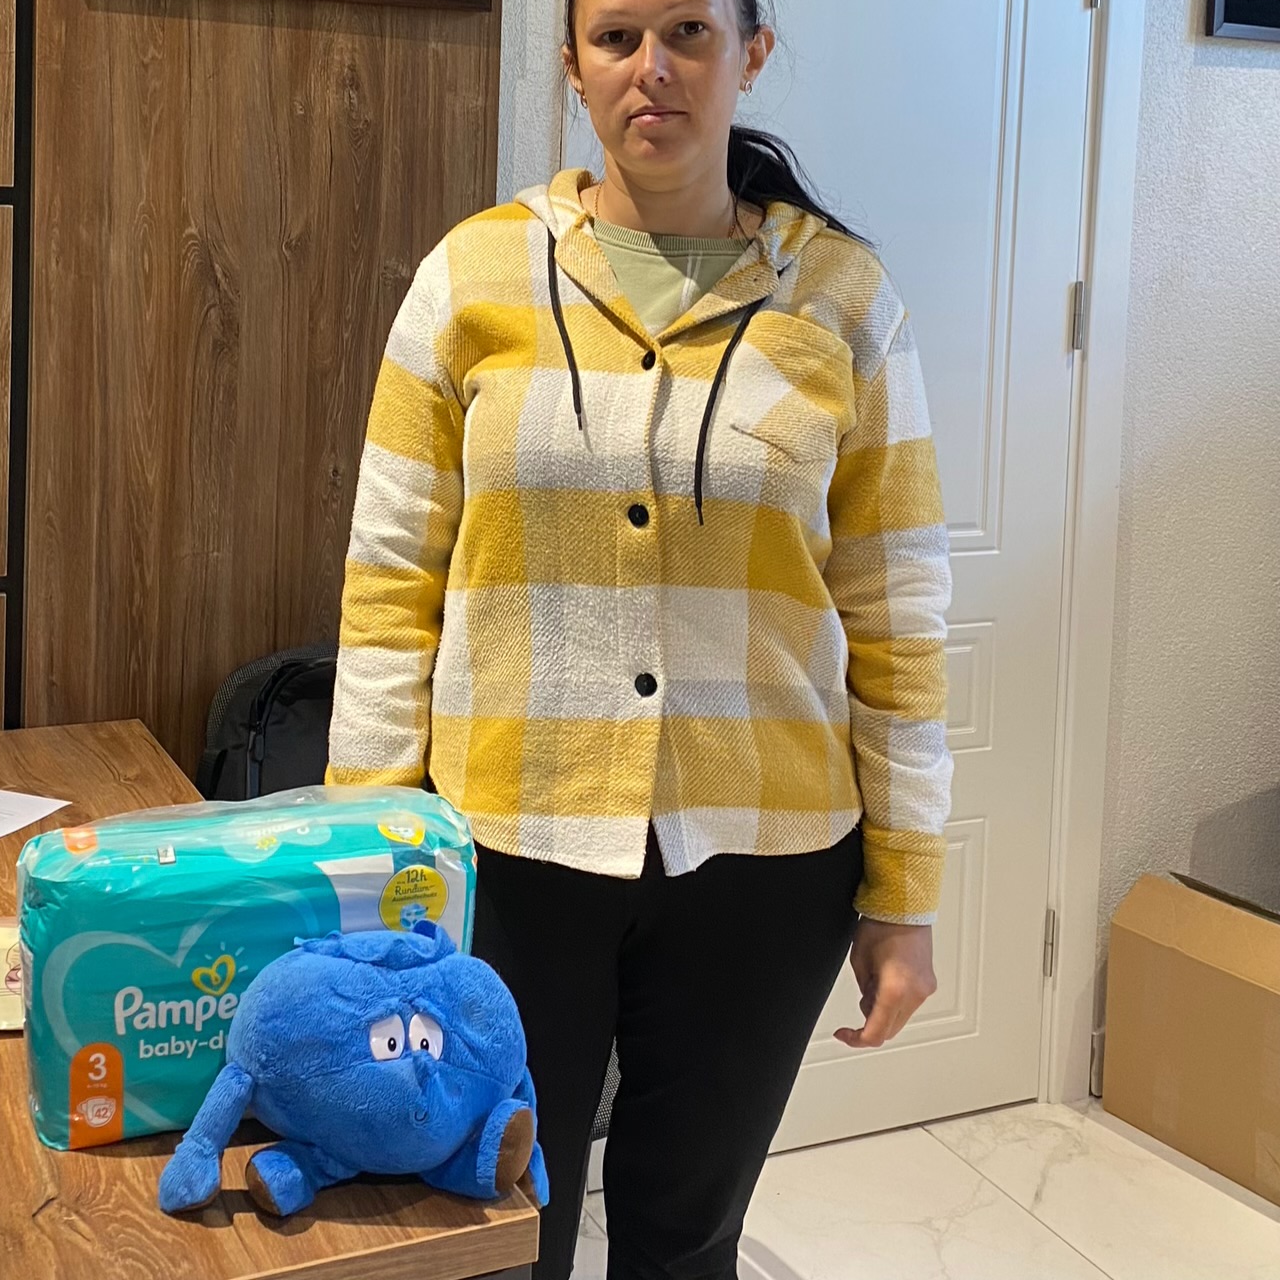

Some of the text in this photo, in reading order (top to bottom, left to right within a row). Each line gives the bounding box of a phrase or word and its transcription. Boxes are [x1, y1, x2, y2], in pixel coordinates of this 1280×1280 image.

[405, 869, 427, 883] 12h
[114, 985, 239, 1036] Pampe
[139, 1030, 228, 1059] baby-d
[88, 1052, 107, 1082] 3
[94, 1107, 109, 1120] 42
